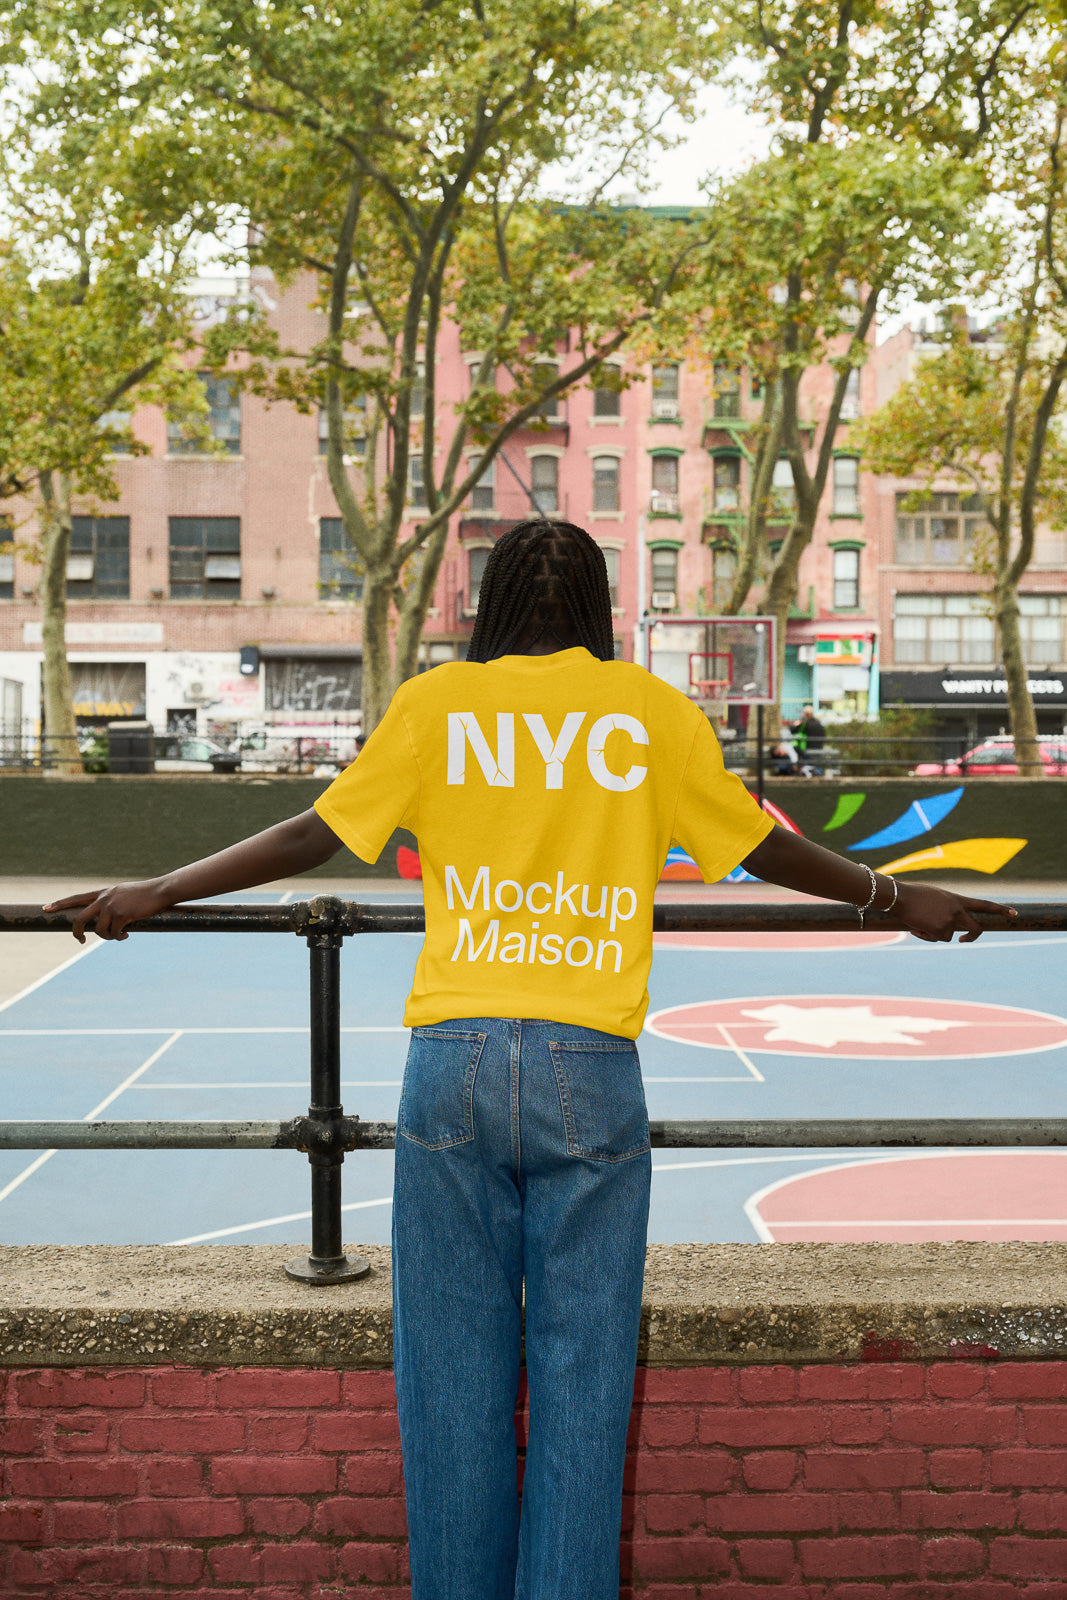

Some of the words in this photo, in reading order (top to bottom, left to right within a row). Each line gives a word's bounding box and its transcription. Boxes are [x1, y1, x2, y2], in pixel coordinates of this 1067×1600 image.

[447, 711, 650, 792] NYC
[444, 865, 638, 932] Mockup
[450, 918, 623, 974] Maison
